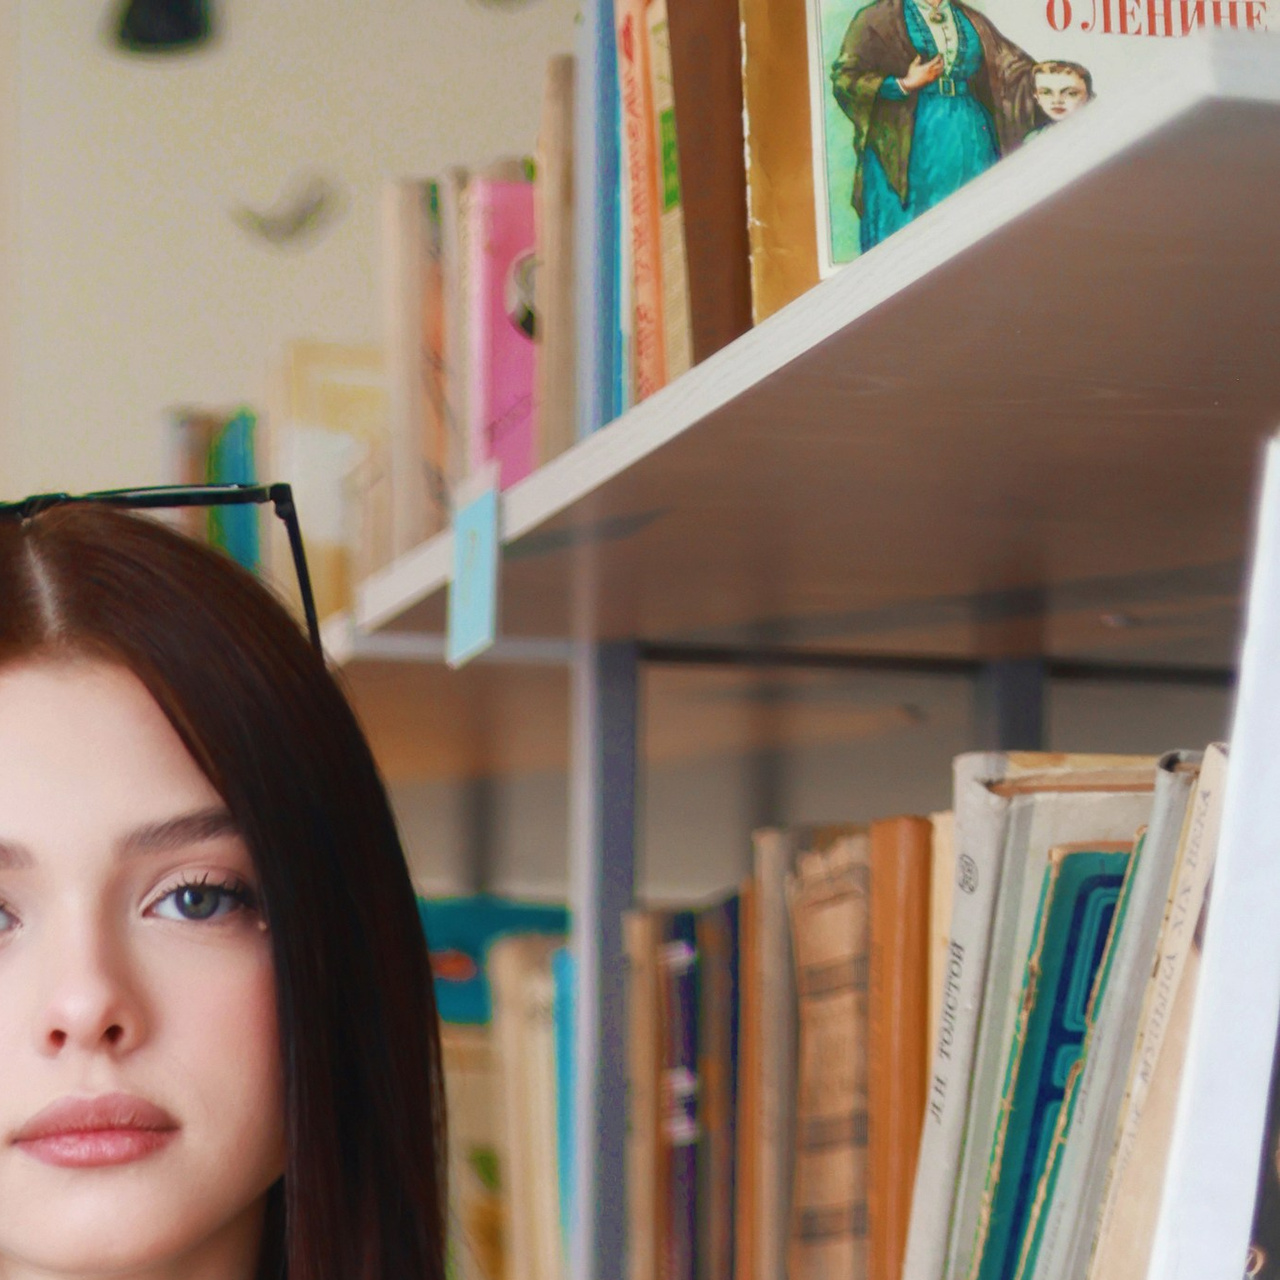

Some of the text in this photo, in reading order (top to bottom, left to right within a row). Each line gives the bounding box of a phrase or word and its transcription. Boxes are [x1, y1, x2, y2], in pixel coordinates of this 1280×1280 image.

[1046, 0, 1268, 38] О ЛЕНИНЕ
[937, 940, 966, 1060] ТОЛСТОЙ
